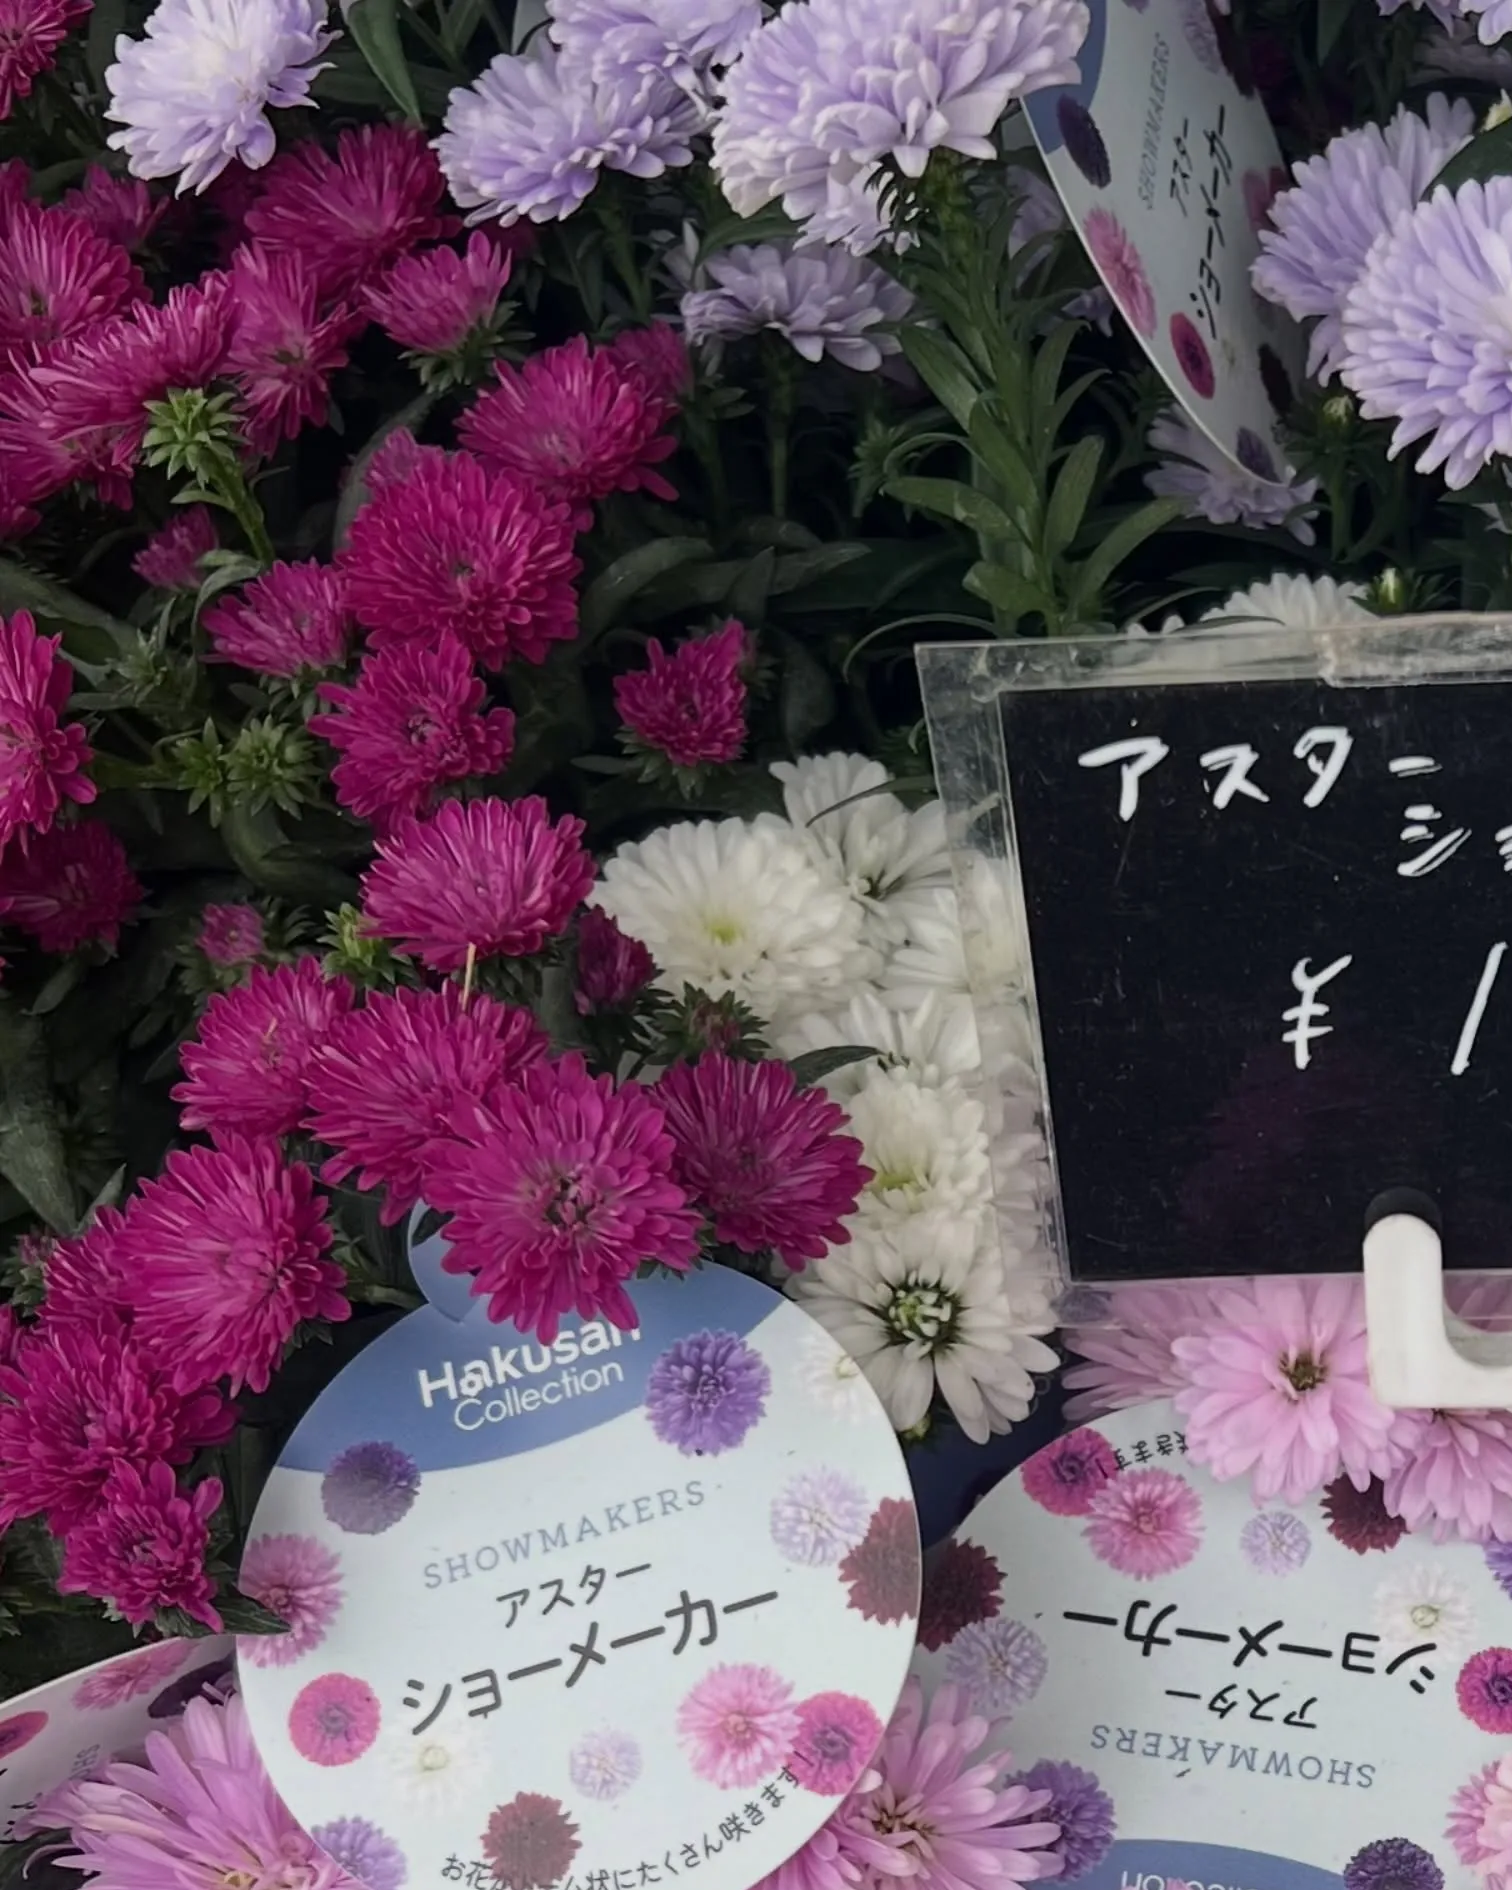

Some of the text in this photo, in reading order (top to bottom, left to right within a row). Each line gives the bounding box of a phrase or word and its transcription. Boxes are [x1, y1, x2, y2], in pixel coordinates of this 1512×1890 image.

[1138, 33, 1171, 210] SHOWMAKERS
[1169, 118, 1192, 217] アスター
[1190, 105, 1232, 339] ショーメーカー
[1078, 726, 1440, 822] アスター
[454, 1361, 625, 1431] Collection
[422, 1480, 704, 1590] SHOWMAKERS
[497, 1563, 652, 1628] アスター
[401, 1591, 779, 1735] ショーメーカー
[1063, 1600, 1437, 1694] ショーメーカー
[1165, 1684, 1317, 1729] アスター
[1091, 1723, 1377, 1789] SHOWMAKERS
